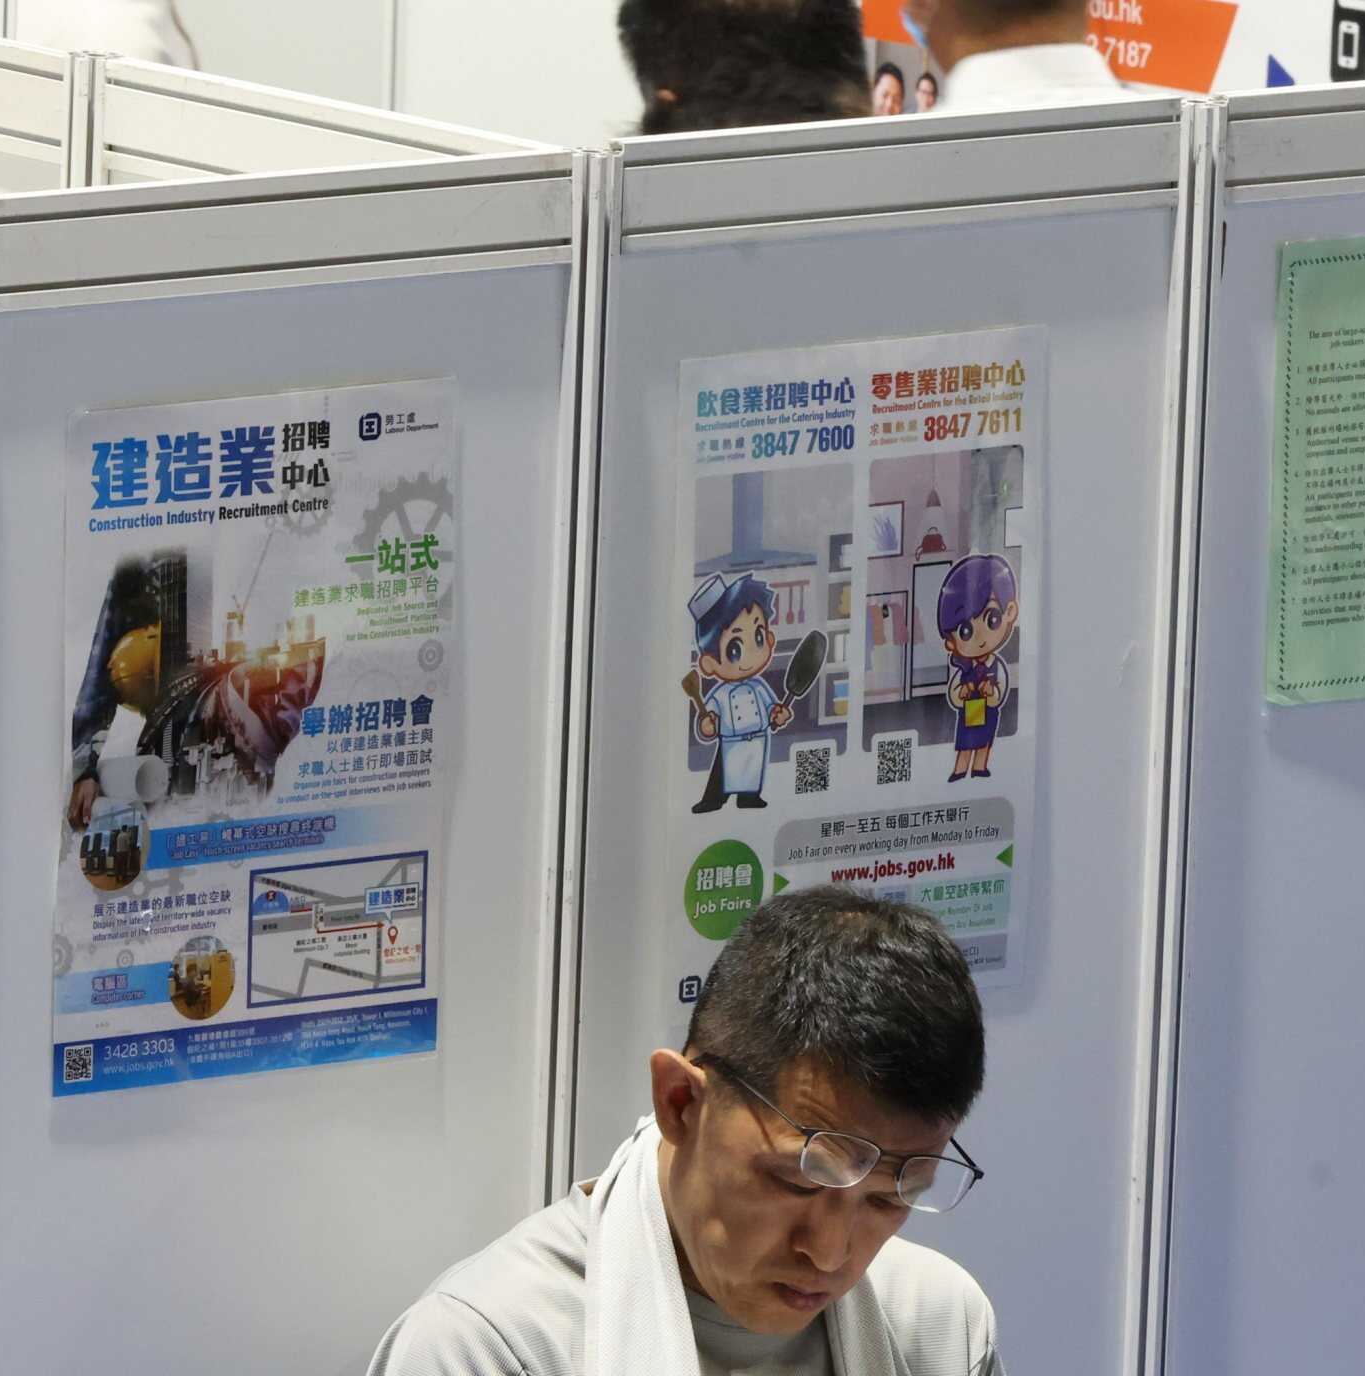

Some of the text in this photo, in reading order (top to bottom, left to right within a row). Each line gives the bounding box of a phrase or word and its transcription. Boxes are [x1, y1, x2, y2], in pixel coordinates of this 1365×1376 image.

[1102, 36, 1152, 69] 7187
[871, 361, 1025, 398] 零售業招聘中心
[696, 377, 855, 417] 飲食業招聘中心
[385, 412, 415, 425] 勞工處
[923, 412, 972, 441] 3847
[977, 406, 1022, 435] 7611
[281, 420, 330, 453] 招聘
[751, 431, 800, 459] 3847
[805, 424, 855, 453] 7600
[91, 425, 275, 509] 建造業
[281, 458, 330, 490] 中心
[89, 498, 329, 531] Construction Industry Recruitment Centre
[344, 534, 439, 578] 一站式
[293, 577, 439, 607] 建造業求職招聘平台
[301, 695, 433, 737] 舉辦招聘會
[298, 751, 432, 777] 求職人士進行即場面試
[820, 807, 971, 837] 星期一至五 每個工作天舉行
[788, 826, 999, 860] Job Fair on every working day from Monday to Friday
[695, 864, 752, 889] 招聘會
[831, 853, 955, 883] www.jobs.gov.hk
[693, 896, 752, 918] Job Fairs
[104, 1037, 176, 1061] 3428 3303
